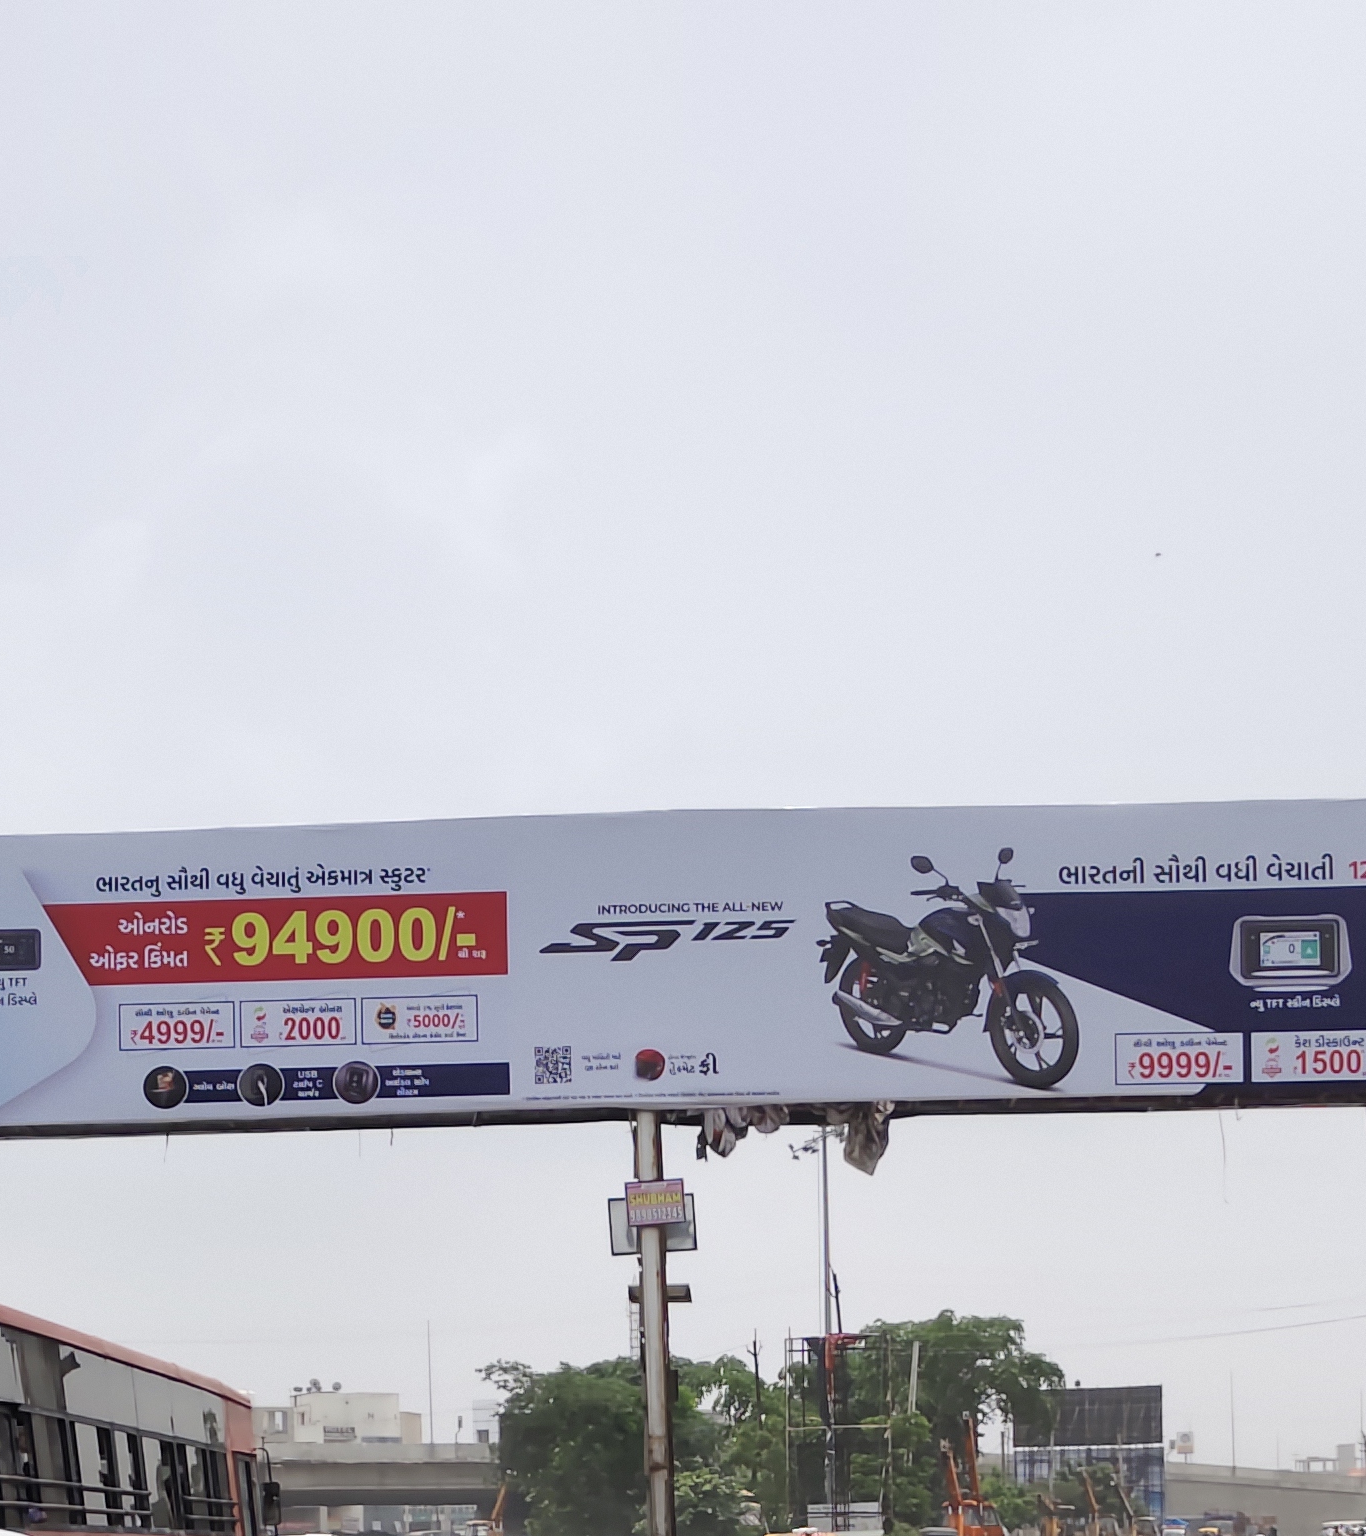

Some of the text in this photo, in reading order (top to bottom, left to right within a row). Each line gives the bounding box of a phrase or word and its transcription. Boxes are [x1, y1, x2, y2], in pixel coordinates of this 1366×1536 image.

[1057, 857, 1145, 885] ભારતની
[1153, 854, 1207, 884] સૌથી
[1215, 855, 1257, 883] વધી
[1266, 853, 1333, 881] વેચાતી
[96, 864, 426, 897] ભારતનુ સૌથી વધુ વેચાતું એકમાત્ર સ્કુટર
[597, 901, 784, 915] INTRODUCING THE ALL-NEW
[118, 911, 188, 936] ઓનરોડ
[538, 919, 797, 962] SP 125
[89, 942, 188, 971] ઓફર કિંમત
[8, 977, 27, 987] TFT
[1265, 998, 1284, 1008] TFT
[297, 1070, 318, 1079] USB
[629, 1192, 682, 1207] SHUBHAM
